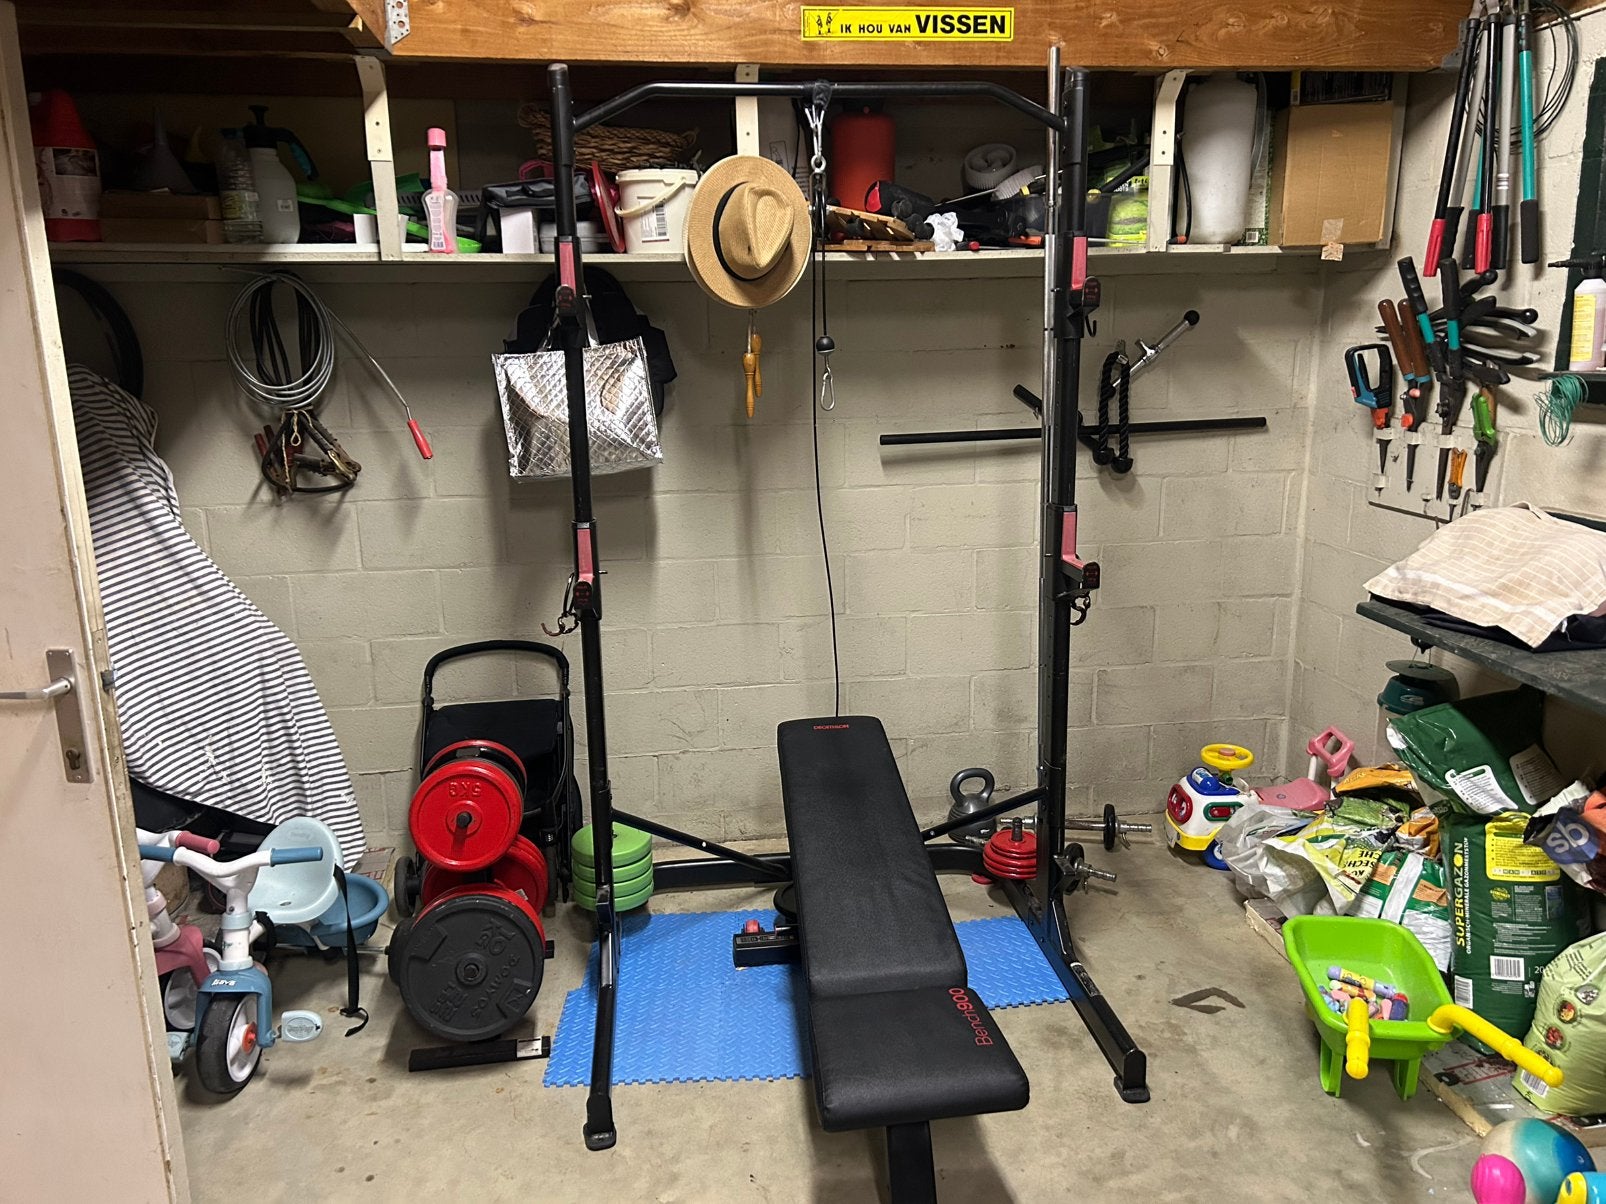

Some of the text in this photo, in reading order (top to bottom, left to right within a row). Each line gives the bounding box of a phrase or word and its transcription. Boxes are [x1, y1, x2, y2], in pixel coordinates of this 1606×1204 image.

[840, 14, 1006, 35] IK HOU VAN VISSEN
[1453, 842, 1466, 948] SUPERGAZON
